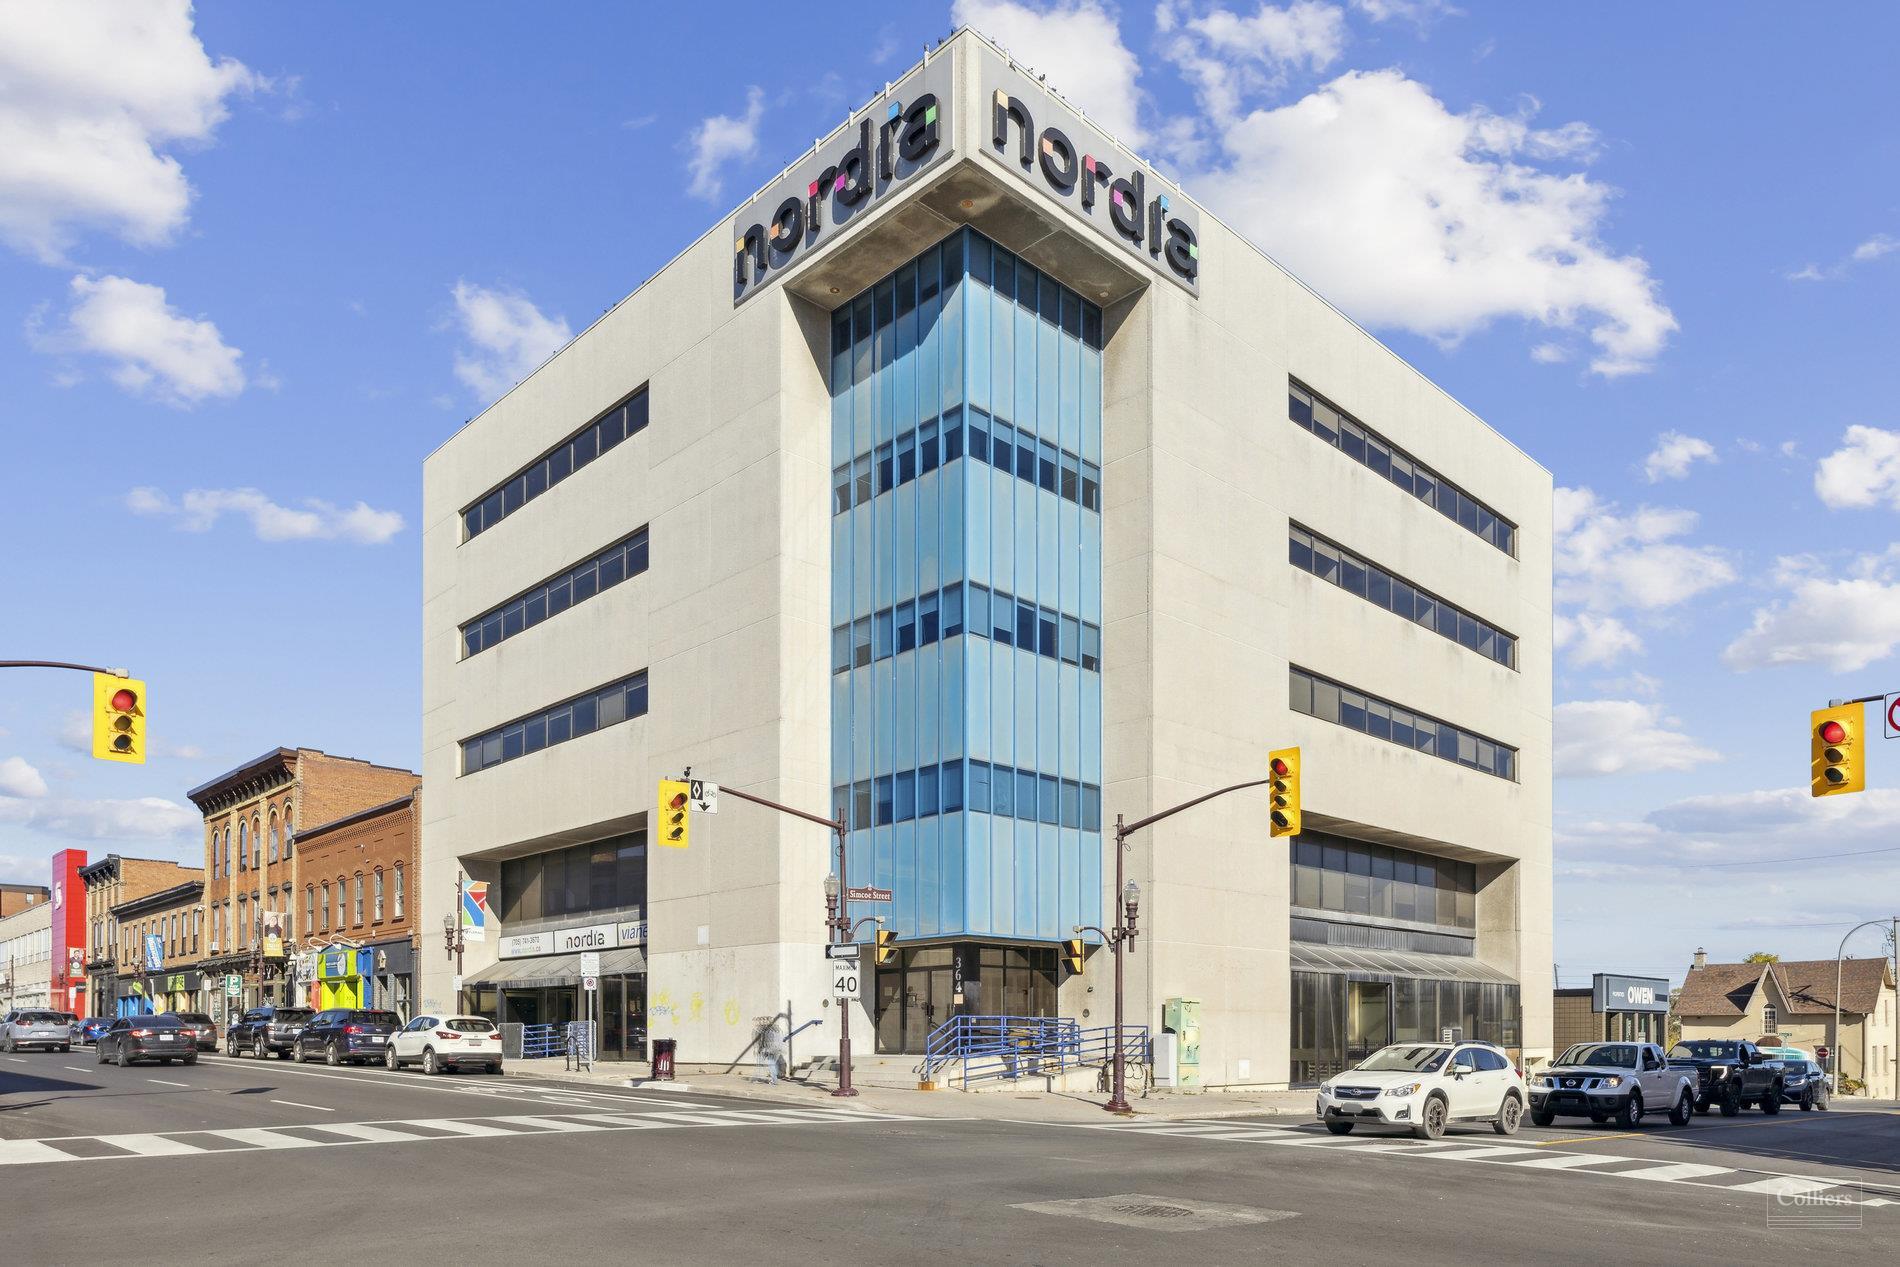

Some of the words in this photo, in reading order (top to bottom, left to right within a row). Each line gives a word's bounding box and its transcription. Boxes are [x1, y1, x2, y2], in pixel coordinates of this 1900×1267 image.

[735, 93, 940, 285] nordia
[993, 88, 1198, 279] nordia
[849, 889, 872, 899] Simcoe
[873, 891, 891, 900] Street
[566, 929, 605, 949] nordia
[835, 976, 857, 992] 40
[1627, 986, 1653, 1004] OWEN
